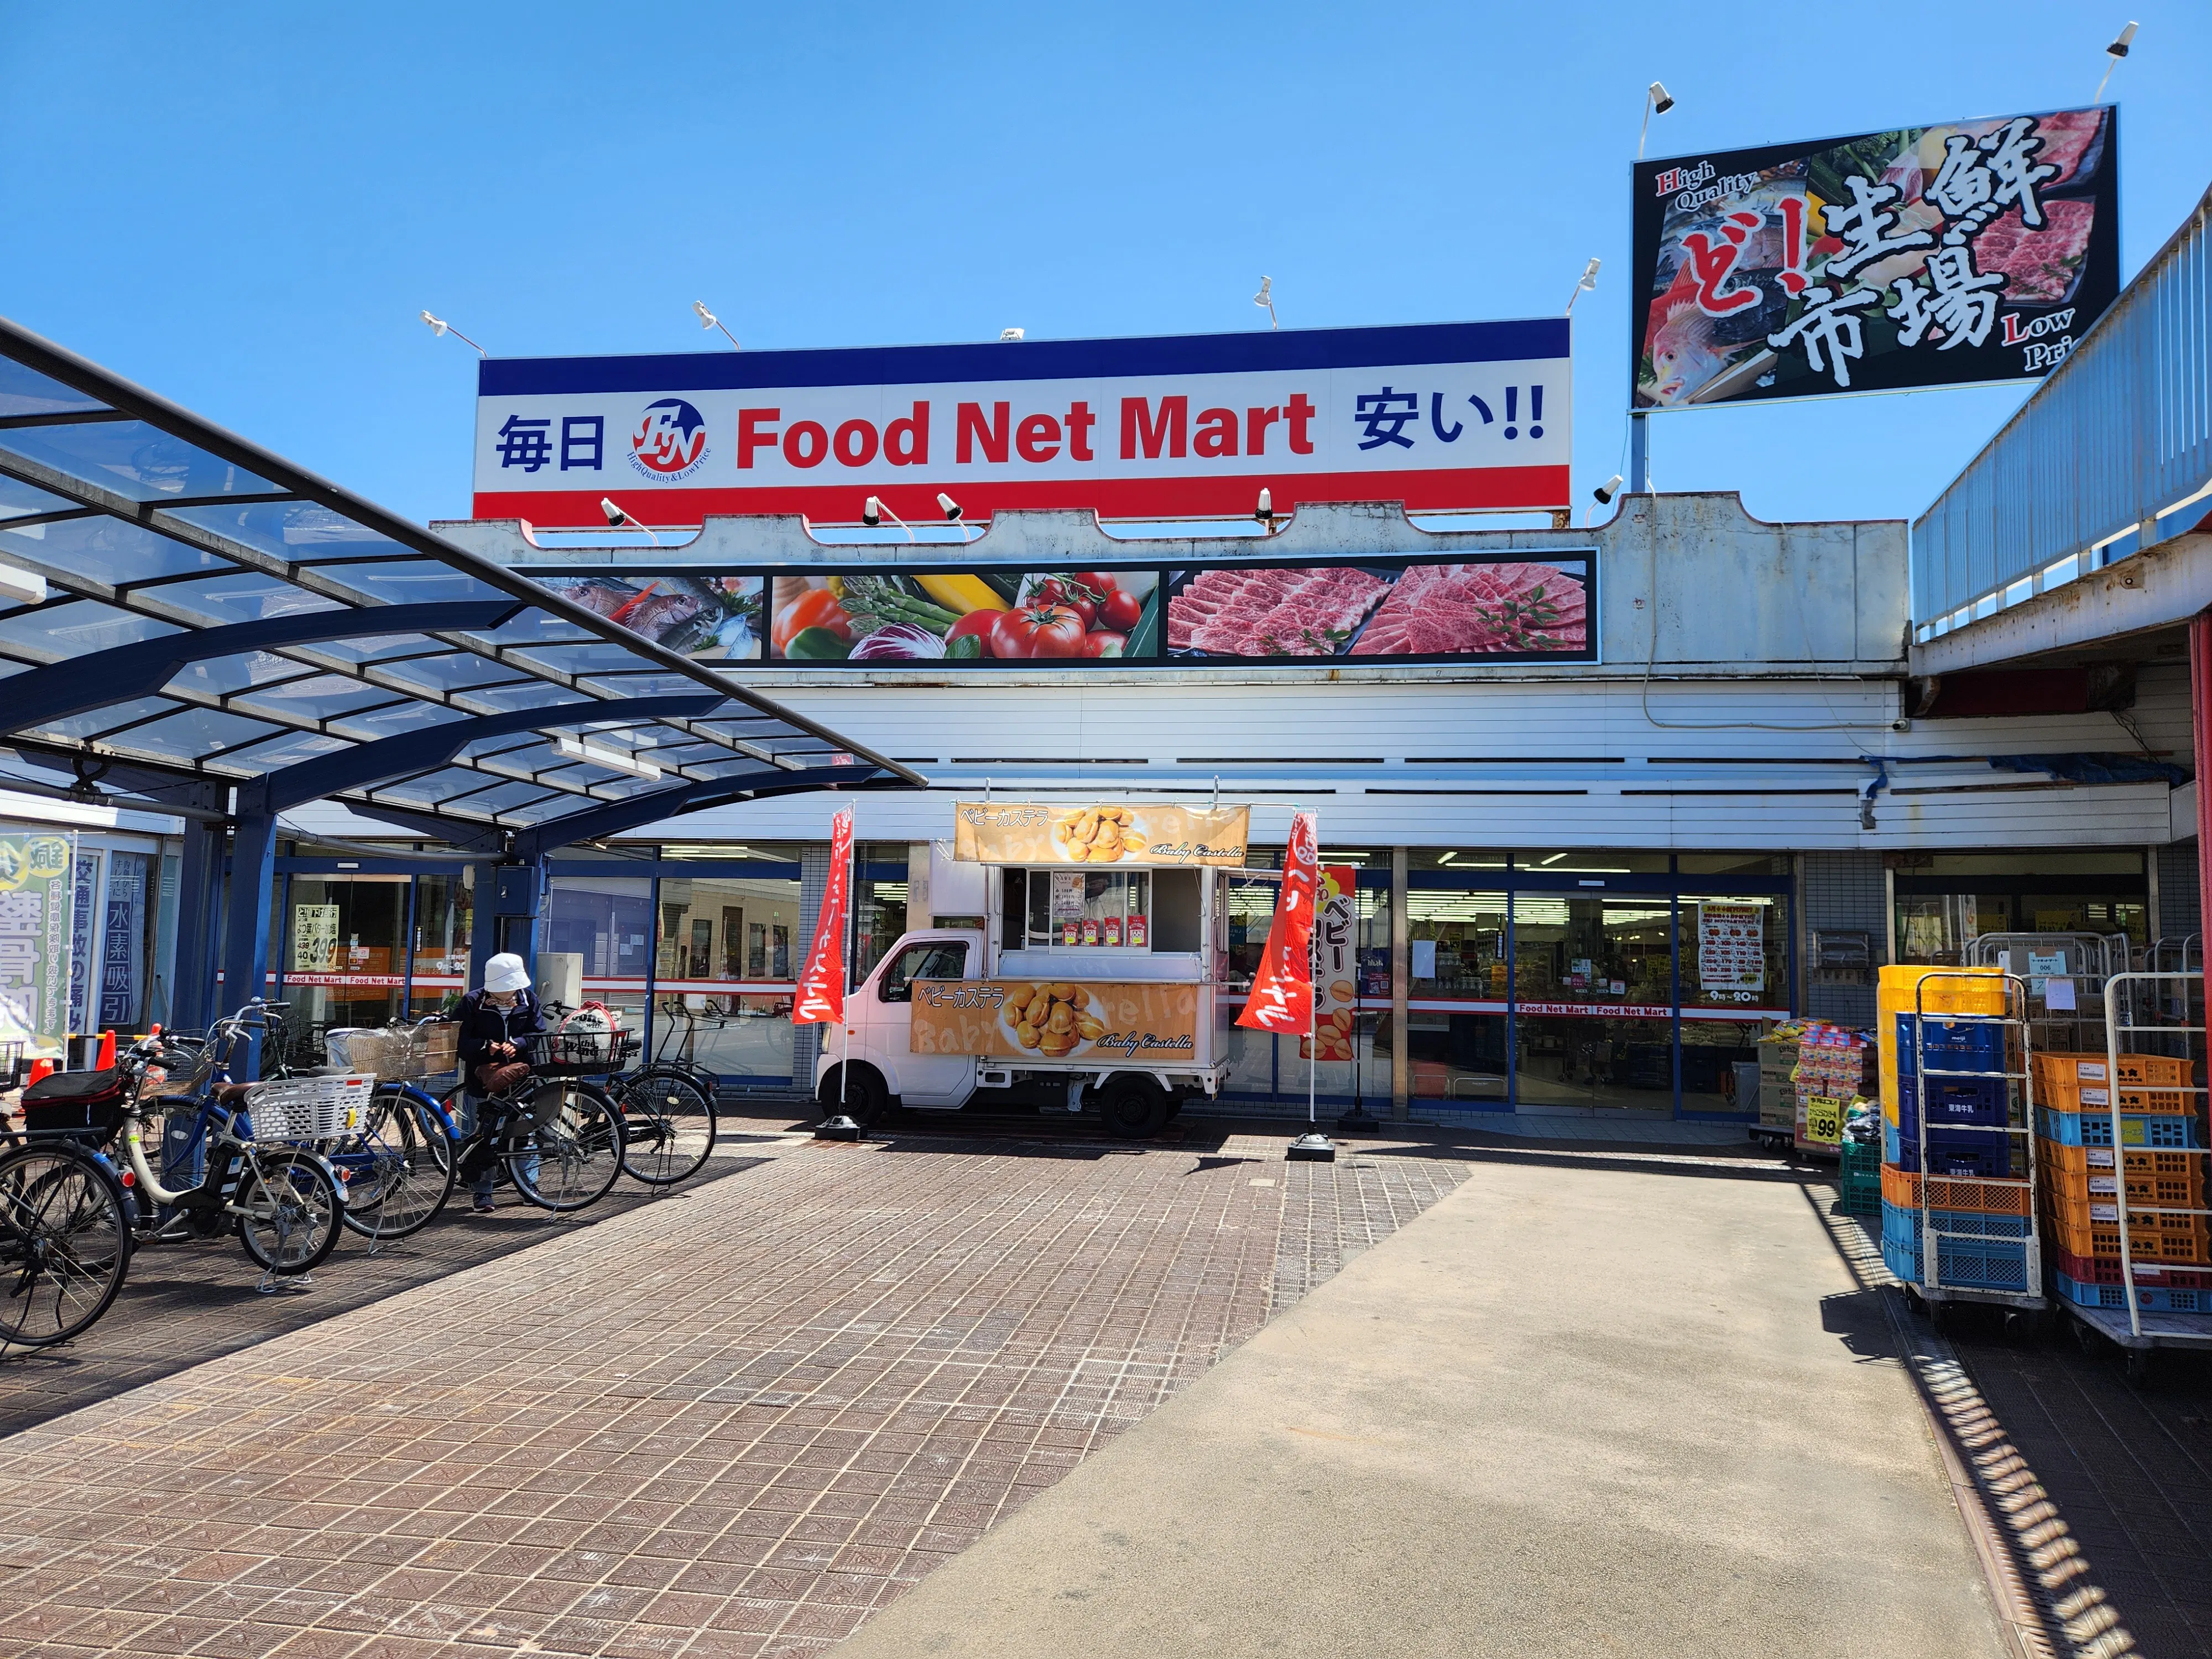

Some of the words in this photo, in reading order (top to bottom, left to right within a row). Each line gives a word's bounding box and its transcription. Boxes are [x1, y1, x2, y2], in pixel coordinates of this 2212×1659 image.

[1656, 160, 1715, 197] High
[1675, 171, 1757, 212] Quality
[2000, 307, 2075, 347] Low
[2023, 335, 2081, 372] Pri
[496, 414, 604, 473] 毎日
[737, 401, 929, 469] Food
[956, 400, 1095, 464] Net
[1120, 393, 1316, 460] Mart
[1354, 385, 1545, 450] 安い!!
[959, 808, 1049, 827] ベビーカステラ
[1149, 842, 1192, 864] Baby
[1193, 843, 1245, 859] Castella
[1325, 896, 1350, 972] ベビー
[105, 903, 128, 1021] 水素吸引
[310, 937, 337, 963] 399
[918, 987, 1004, 1009] ベビーカステラ
[1519, 1003, 1543, 1013] Food
[1546, 1004, 1563, 1013] Net
[1566, 1005, 1589, 1014] Mart
[1597, 1006, 1620, 1015] Food
[1624, 1006, 1641, 1016] Net
[1644, 1007, 1667, 1016] Mart
[1097, 1031, 1140, 1057] Baby
[1141, 1034, 1194, 1050] Castella
[1948, 1104, 1974, 1113] 東海牛乳
[1817, 1119, 1835, 1138] 99
